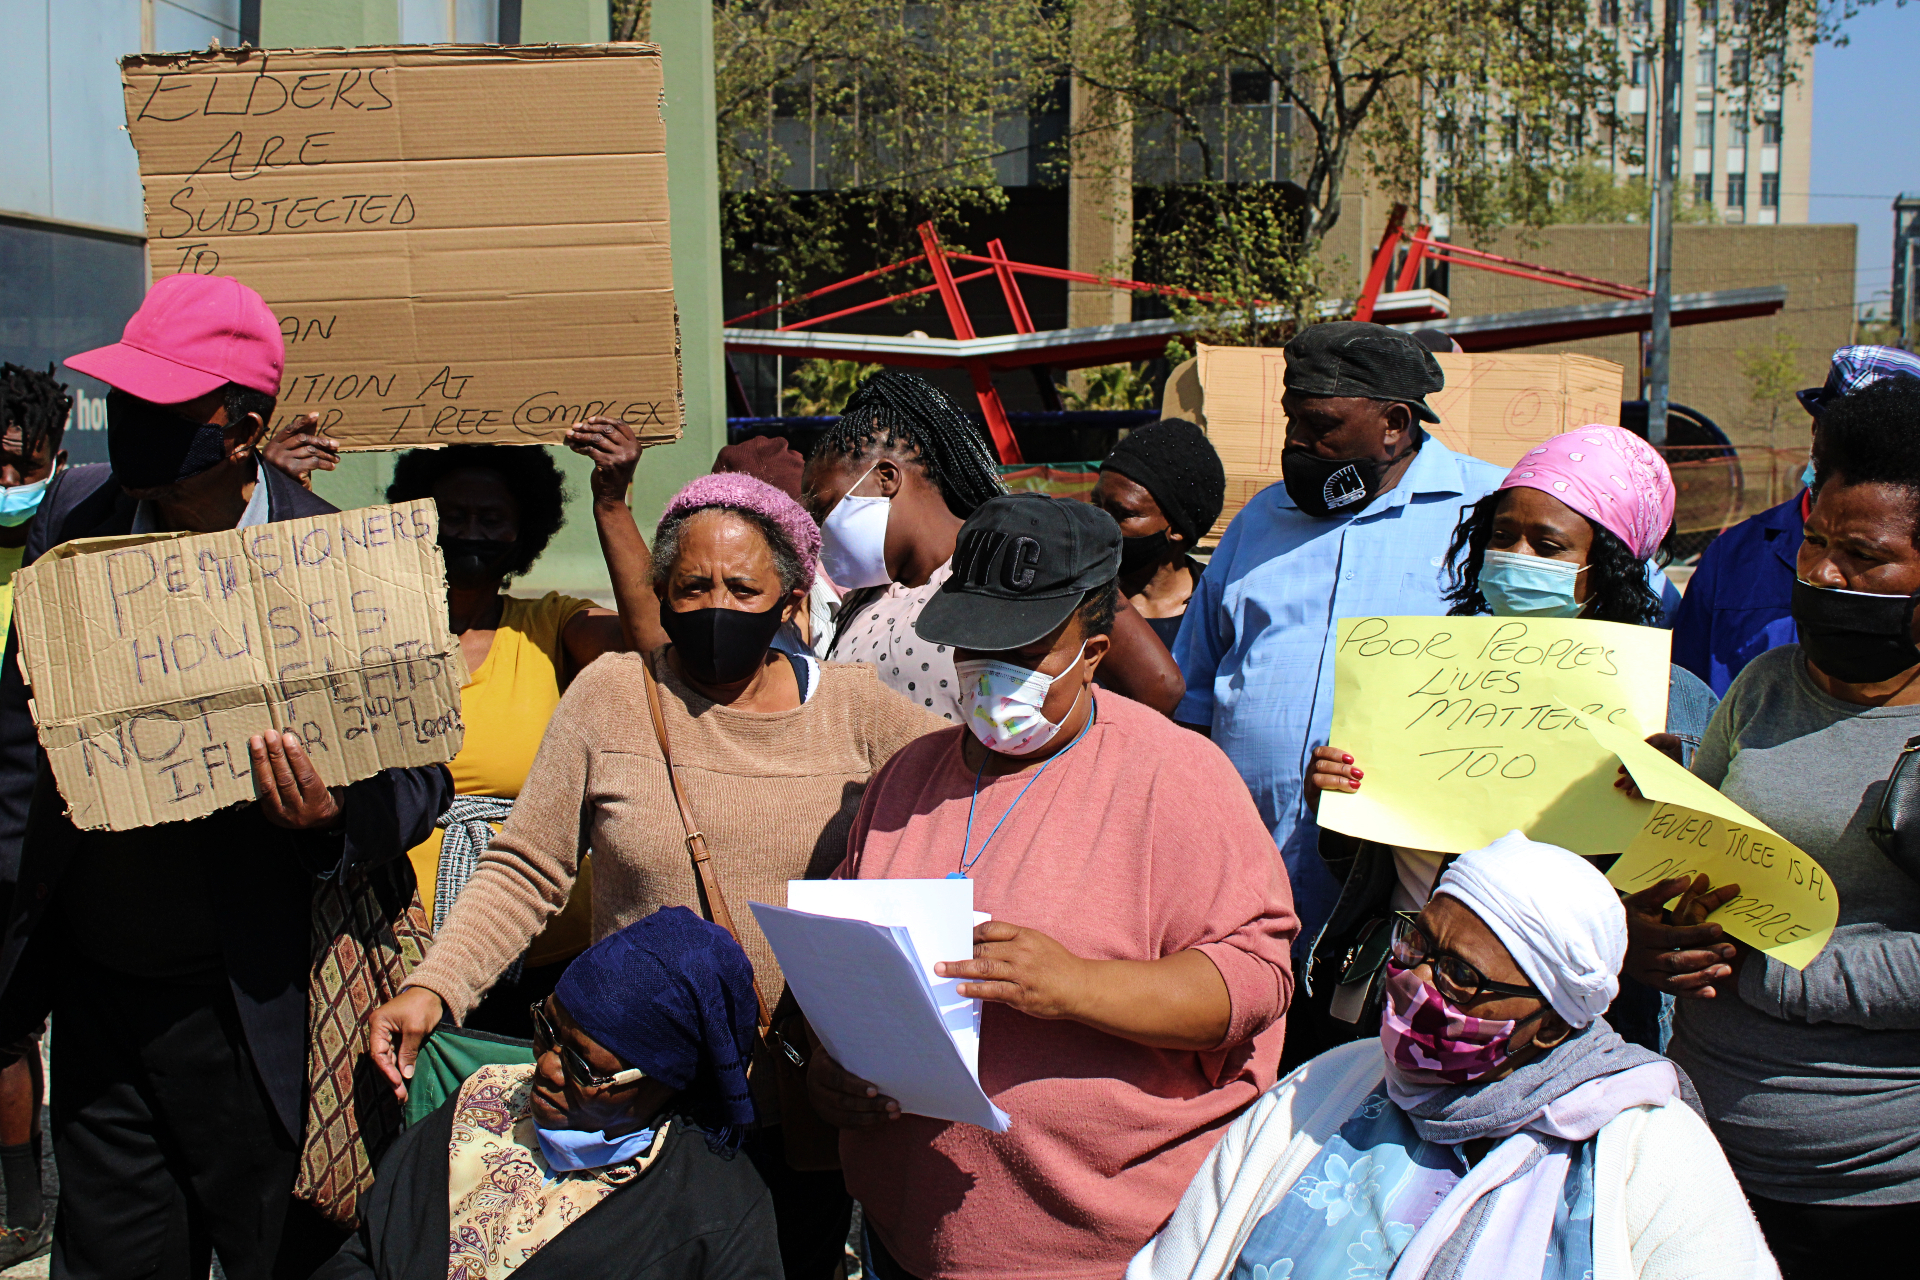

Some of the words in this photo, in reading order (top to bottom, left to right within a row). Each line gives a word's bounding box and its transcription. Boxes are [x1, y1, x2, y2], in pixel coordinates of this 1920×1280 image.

[137, 56, 393, 121] ELDERS
[186, 131, 335, 182] ARE
[160, 187, 416, 239] SUBJECTED
[176, 244, 220, 275] TO
[278, 373, 396, 403] ITION
[416, 366, 474, 400] AT
[382, 403, 503, 442] TREE
[105, 508, 431, 638] PENSIONERS
[132, 590, 387, 686] HOUSES
[1339, 617, 1461, 660] POOR
[77, 696, 217, 777] NOT
[1418, 745, 1537, 781] TOO
[1644, 803, 1714, 847] FEVER
[1725, 827, 1776, 868] TREE
